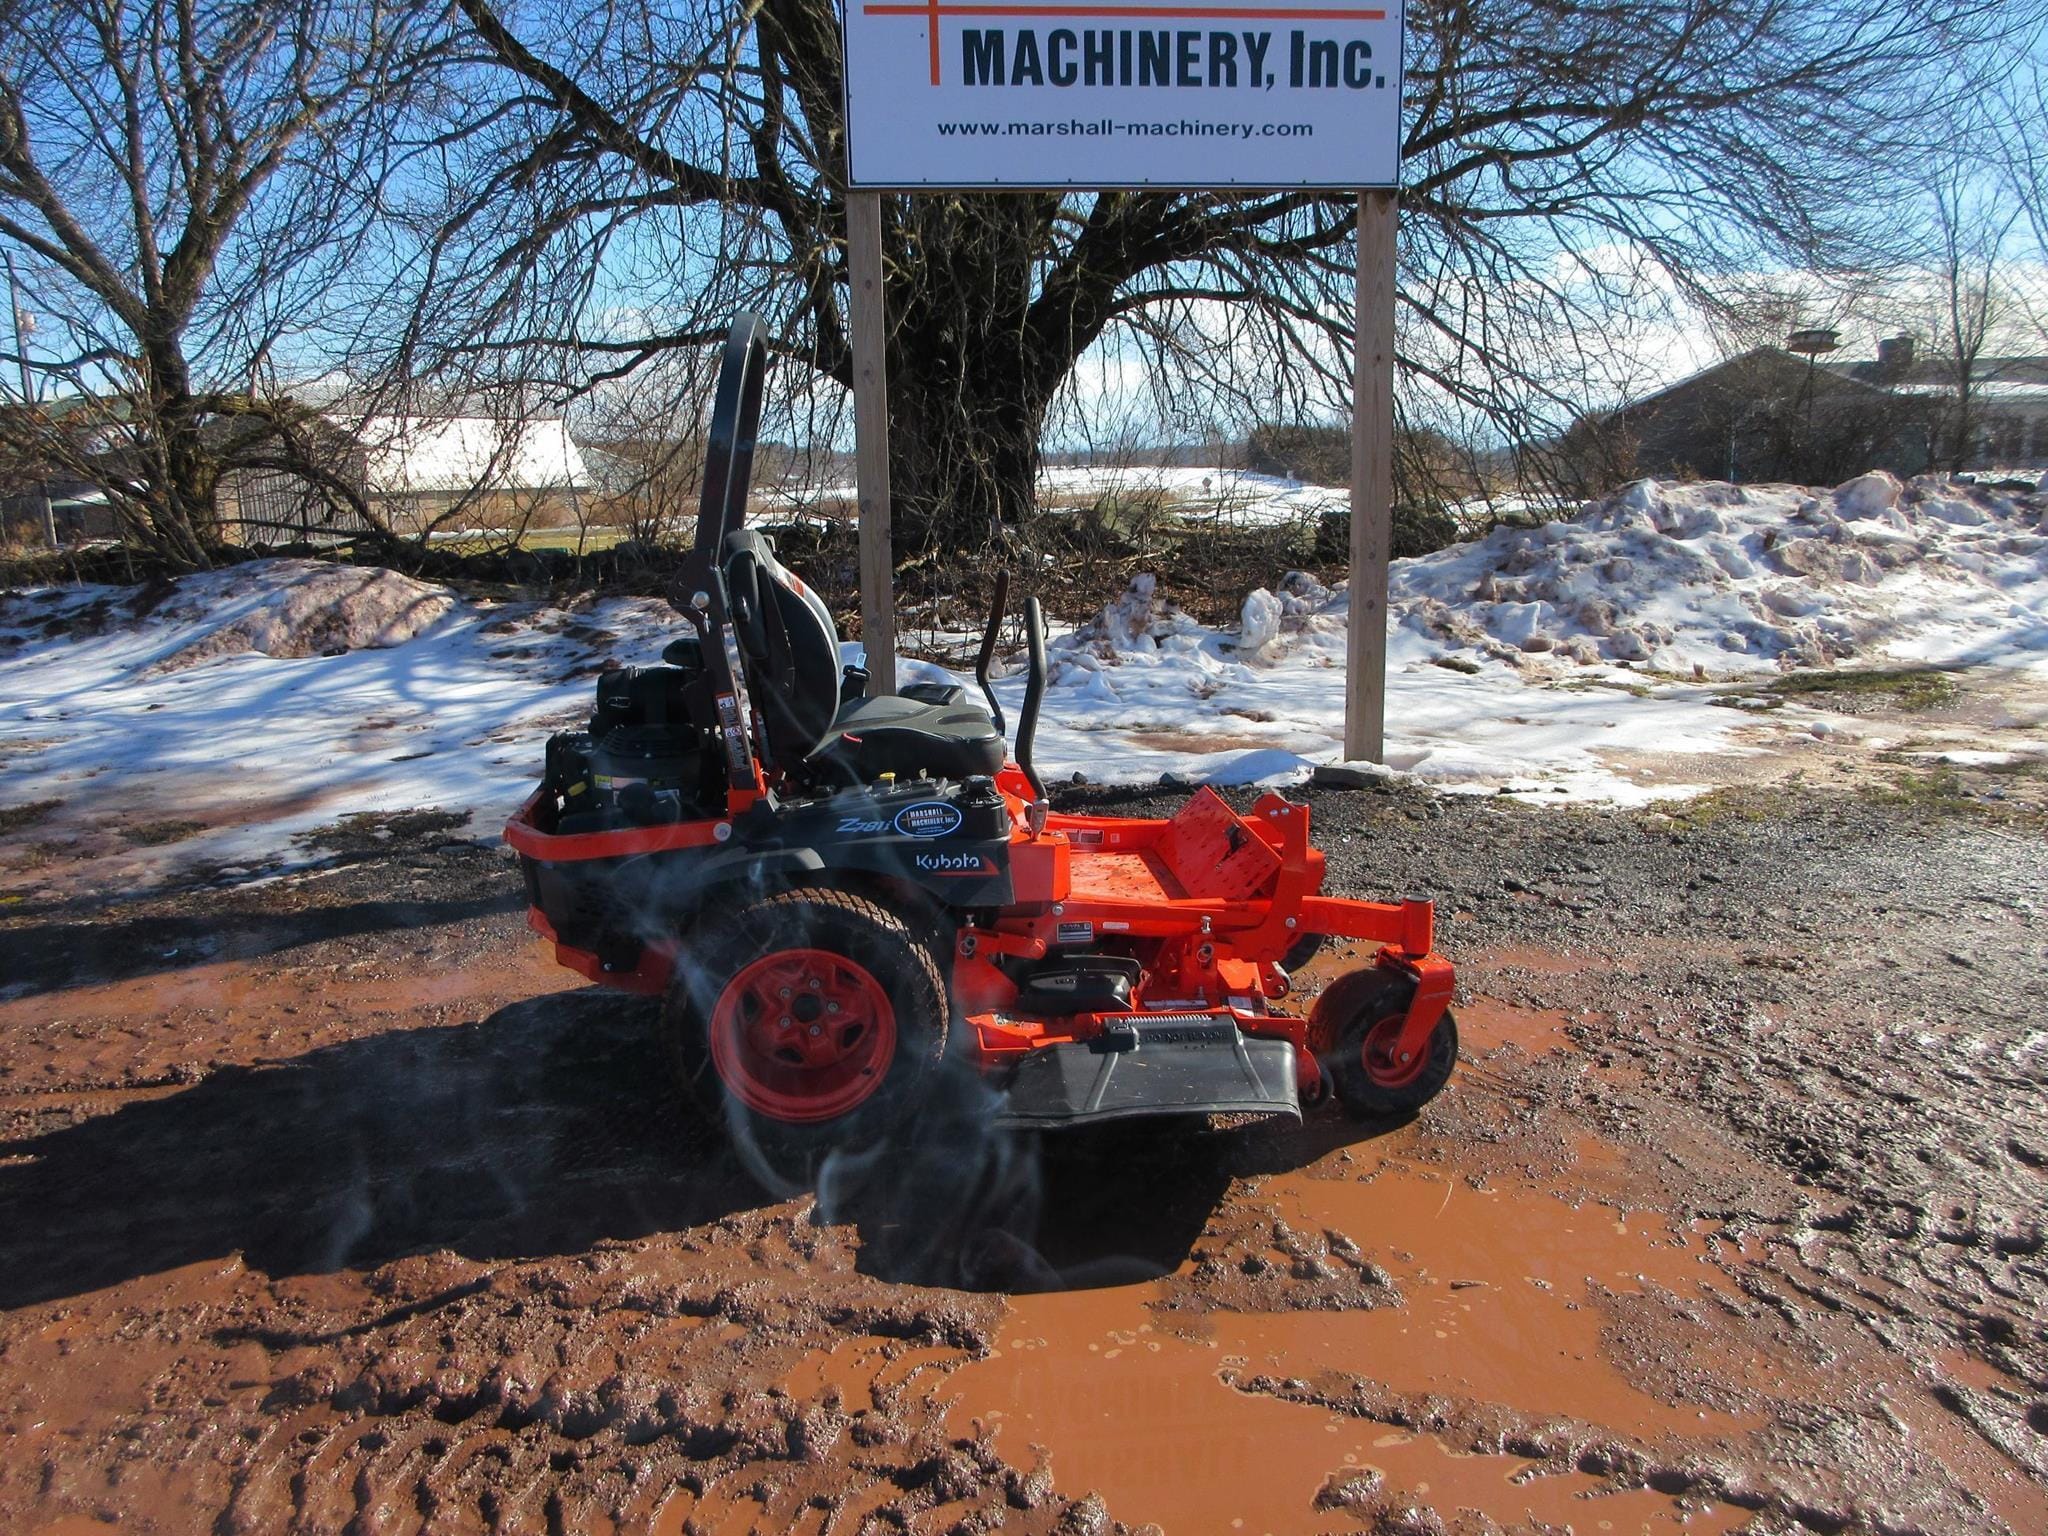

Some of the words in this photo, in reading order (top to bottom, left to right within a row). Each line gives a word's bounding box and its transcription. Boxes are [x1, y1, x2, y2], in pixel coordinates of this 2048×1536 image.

[962, 28, 1274, 91] MACHINERY,
[1289, 30, 1386, 89] Inc.
[937, 119, 1314, 138] www.marshall-machinery.com
[910, 808, 943, 816] MARSHALL
[916, 853, 980, 869] Kubota
